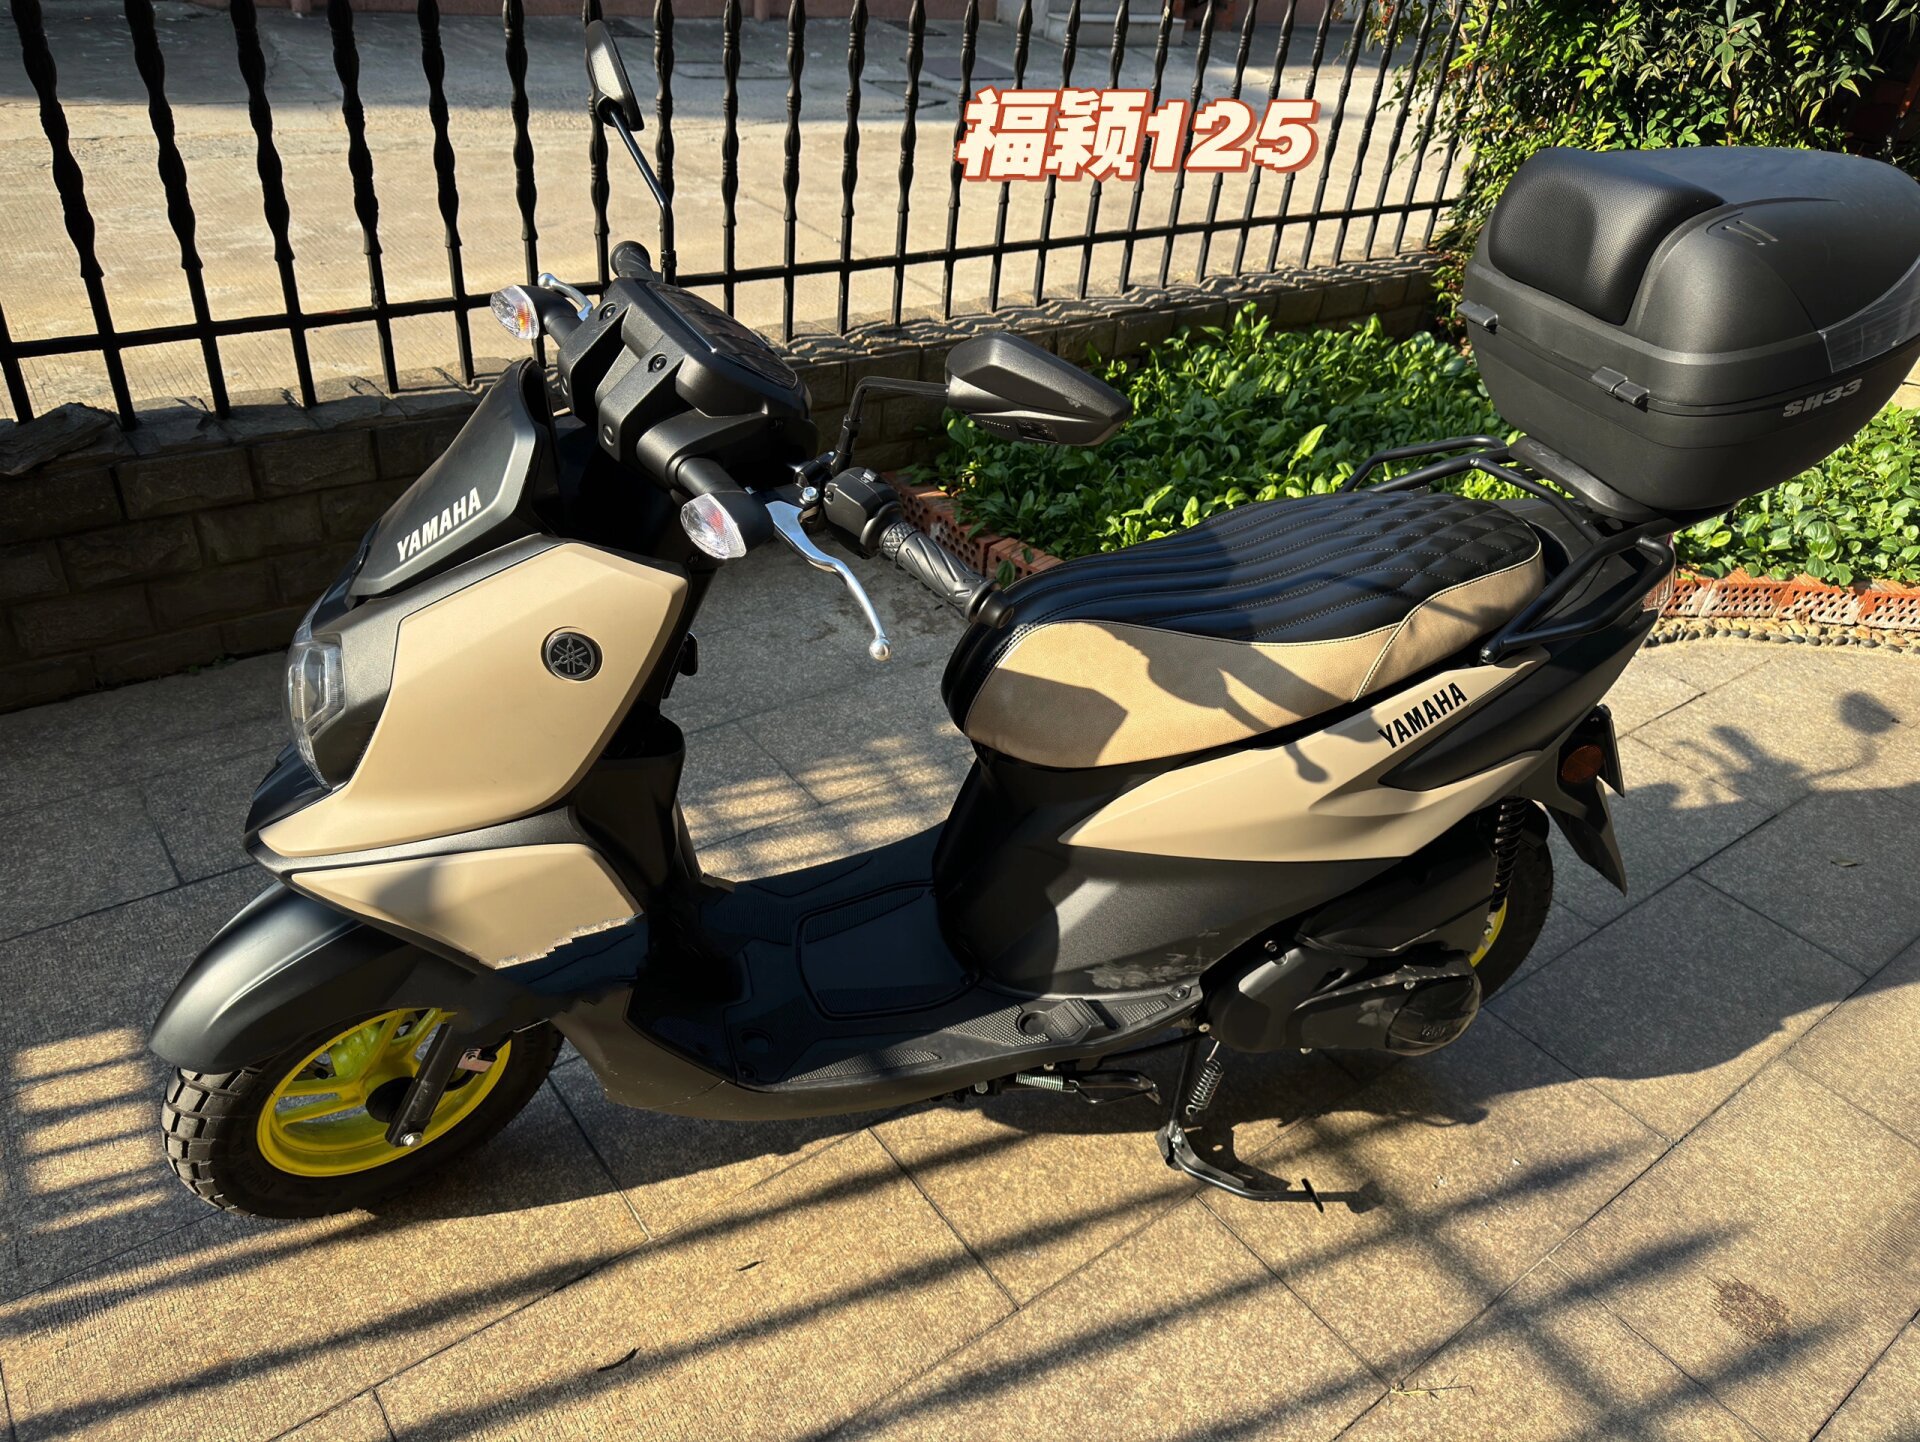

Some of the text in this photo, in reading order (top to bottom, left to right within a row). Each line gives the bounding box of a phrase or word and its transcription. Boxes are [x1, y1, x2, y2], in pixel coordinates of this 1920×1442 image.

[1782, 378, 1863, 418] SH33
[396, 486, 482, 562] YAMAHA
[1376, 682, 1468, 748] YAMAHA
